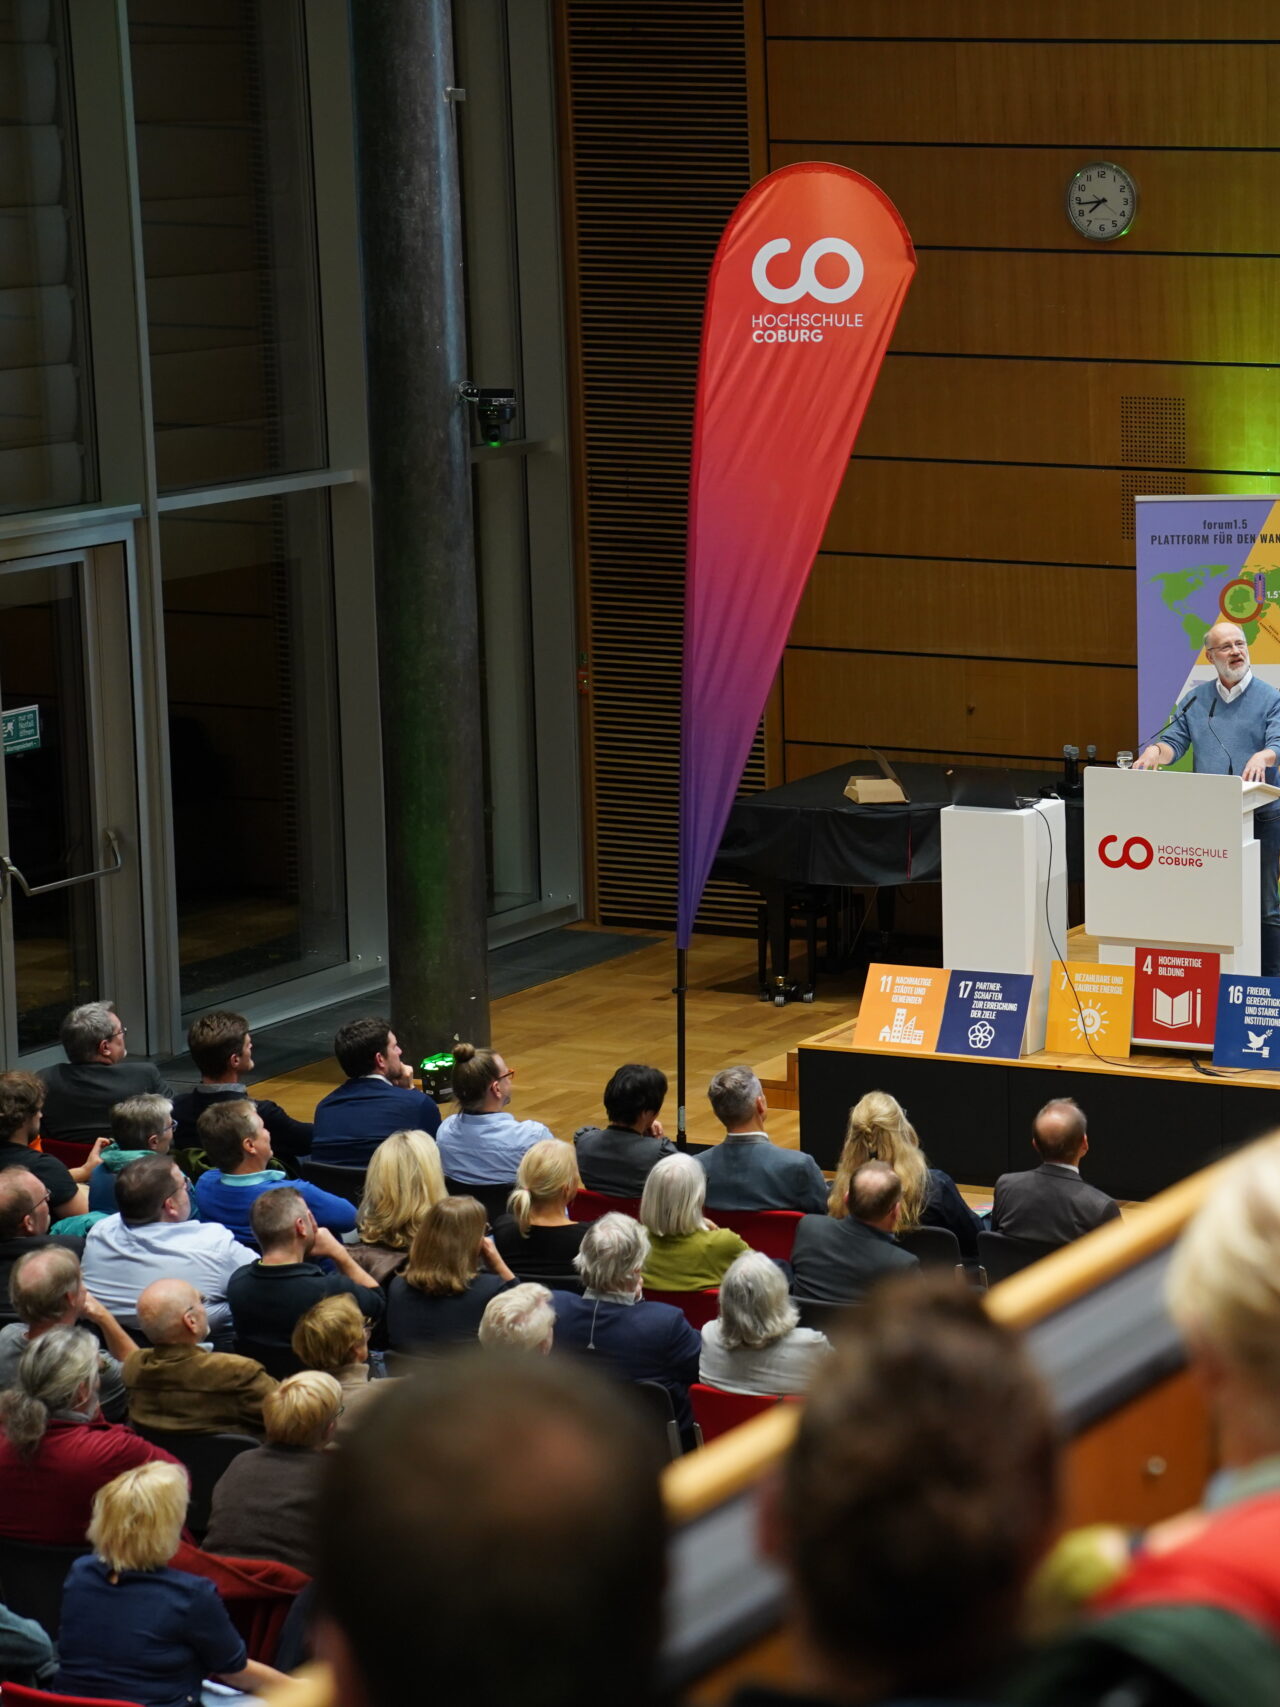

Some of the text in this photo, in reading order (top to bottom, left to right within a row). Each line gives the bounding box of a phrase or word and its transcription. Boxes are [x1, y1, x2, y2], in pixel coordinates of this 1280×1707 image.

[752, 313, 864, 328] HOCHSCHULE
[752, 329, 824, 343] COBURG
[1203, 518, 1248, 530] forum1.5
[1150, 533, 1209, 545] PLATTFORM
[1213, 531, 1233, 545] FÜR
[1236, 533, 1257, 545] DEN
[1158, 845, 1230, 859] HOCHSCHULE
[1158, 855, 1204, 868] COBURG
[1142, 955, 1153, 975] 4
[1158, 955, 1203, 968] HOCHWERTIGE
[1158, 966, 1185, 977] BILDUNG
[879, 975, 893, 993] 11
[975, 981, 1003, 991] PARTNER-
[1111, 976, 1124, 985] UND
[914, 987, 927, 996] UND
[958, 980, 973, 999] 17
[973, 990, 1003, 1001] SCHAFTEN
[1228, 985, 1243, 1004] 16
[1246, 986, 1272, 997] FRIEDEN,
[971, 1000, 1018, 1012] ZUR ERREICHUNG
[1244, 1006, 1280, 1017] UND STARKE
[970, 1009, 997, 1020] DER ZIELE
